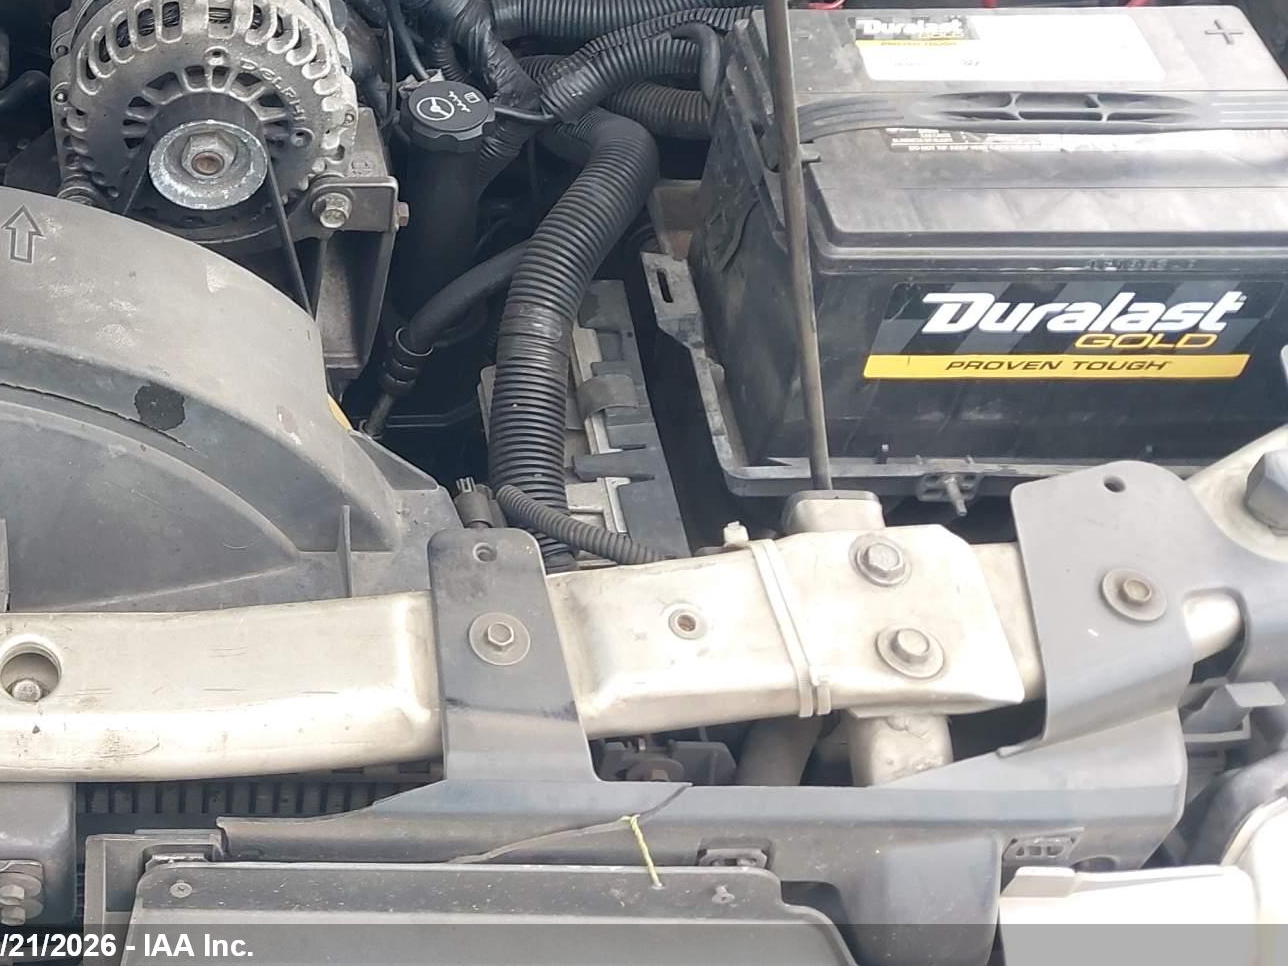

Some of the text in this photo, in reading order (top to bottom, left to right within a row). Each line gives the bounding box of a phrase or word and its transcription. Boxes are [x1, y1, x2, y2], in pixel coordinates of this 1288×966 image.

[240, 57, 306, 120] DELPHI
[922, 291, 1247, 334] Duralast
[1075, 333, 1218, 349] GOLD
[945, 360, 1063, 371] PROVEN
